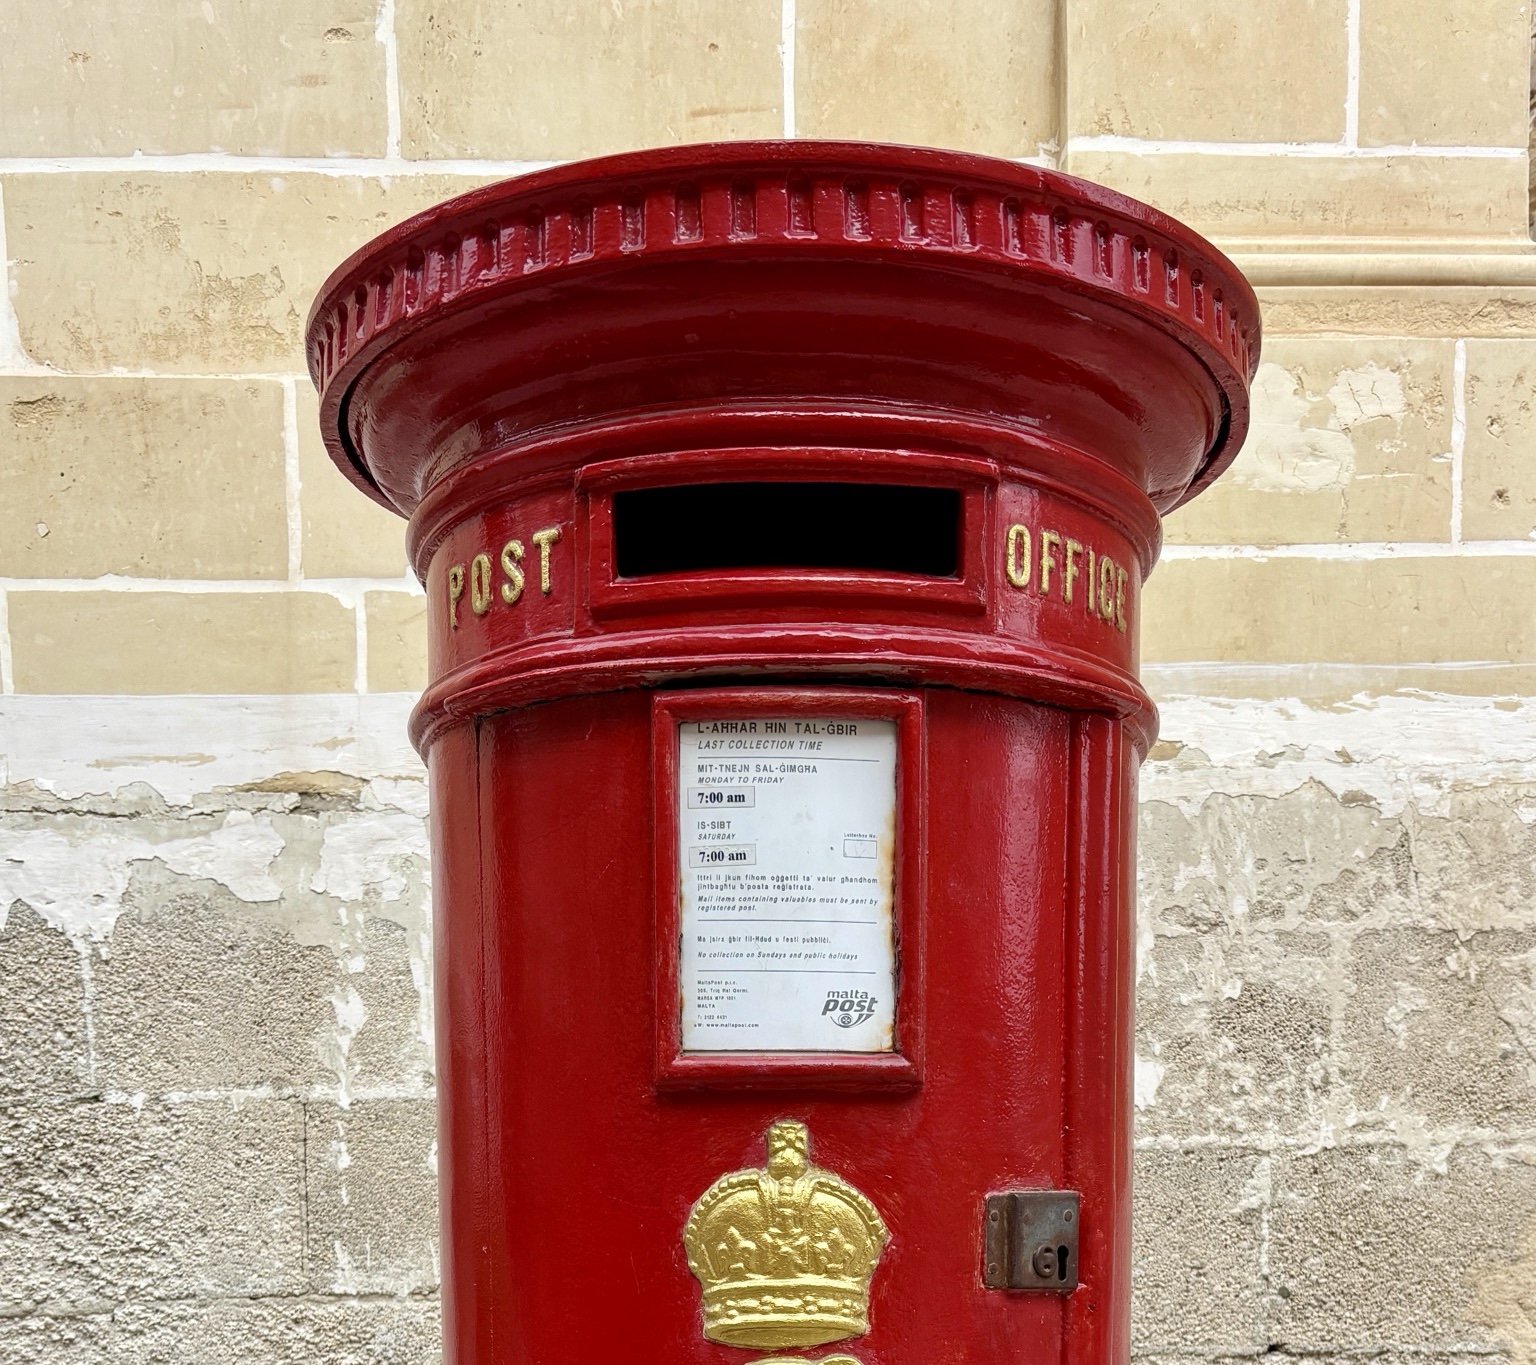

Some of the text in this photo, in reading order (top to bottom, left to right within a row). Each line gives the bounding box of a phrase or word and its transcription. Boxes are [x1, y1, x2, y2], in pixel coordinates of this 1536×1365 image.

[449, 523, 1128, 633] POST OFFICE
[795, 720, 858, 736] TAL-ĠBIR
[697, 740, 823, 751] LAST COLLECTION TIME
[697, 764, 750, 773] MIT-TNEJN
[697, 776, 784, 784] MONDAY TO FRIDAY
[697, 792, 746, 804] 7:00 am
[697, 821, 732, 830] IS-SIBT
[697, 833, 737, 841] SATURDAY
[699, 851, 747, 863] 7:00 am
[725, 874, 741, 883] jkun
[740, 883, 769, 891] b'posta
[738, 895, 778, 904] containing
[869, 898, 878, 906] by
[697, 904, 757, 913] registered post.
[757, 951, 786, 960] Sundays
[804, 952, 826, 960] public
[828, 952, 858, 961] holidays
[827, 989, 869, 999] malta
[821, 996, 878, 1016] post
